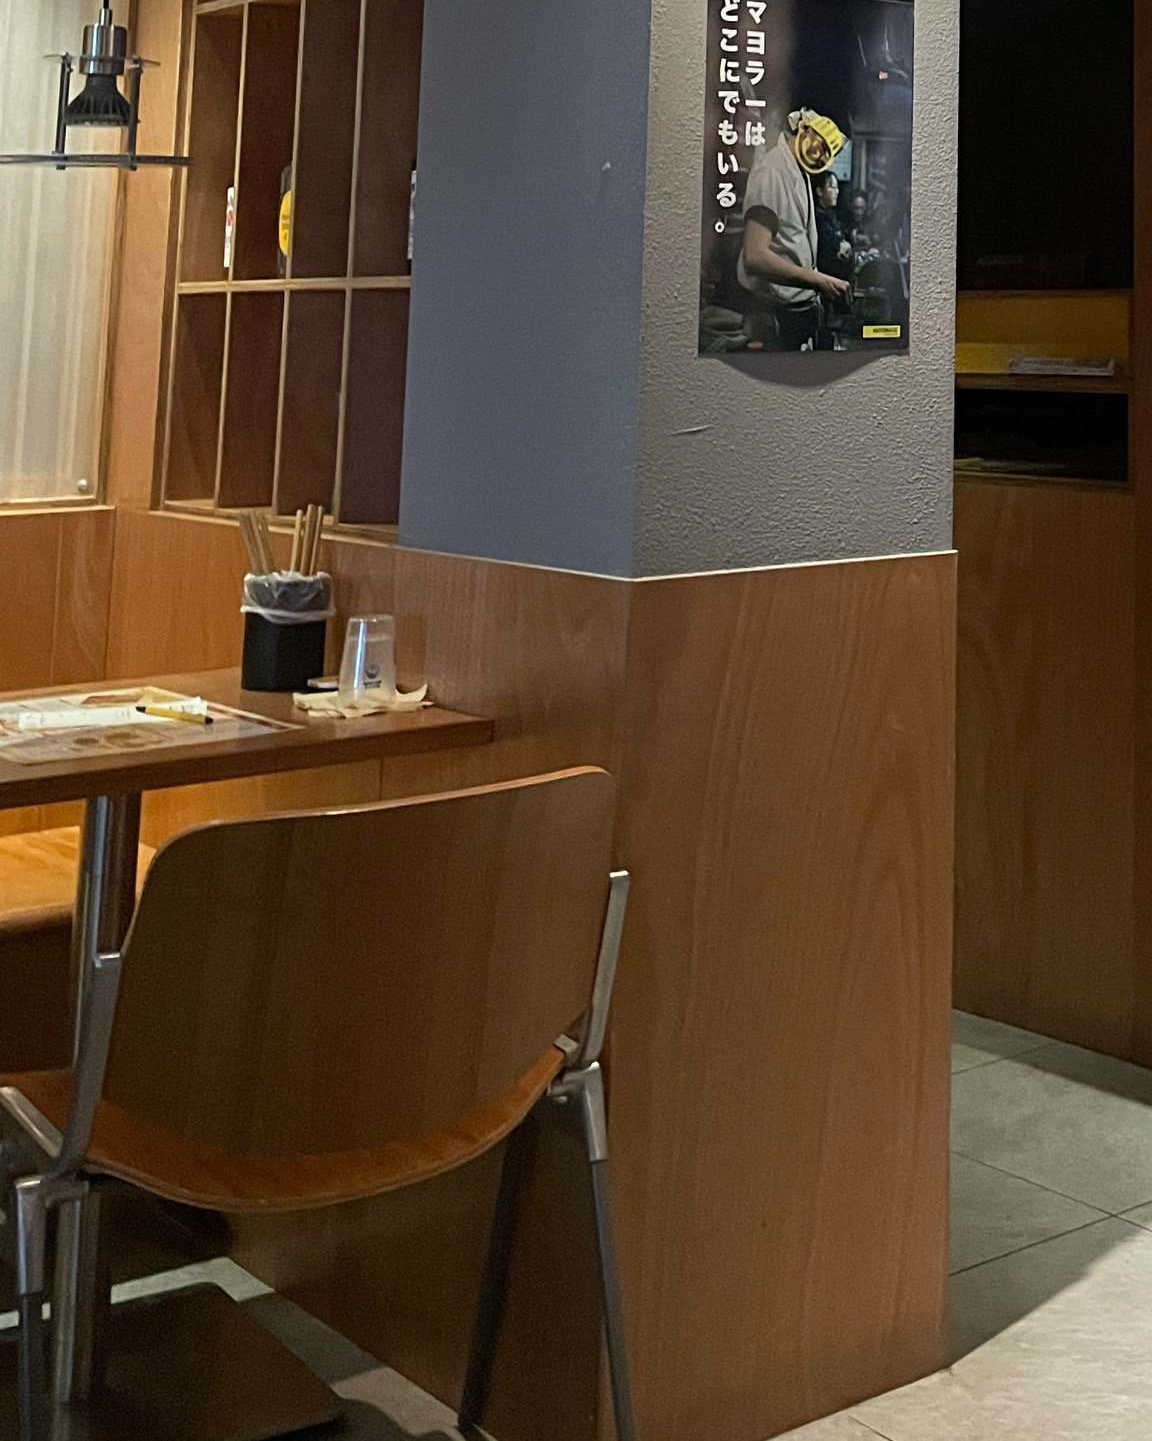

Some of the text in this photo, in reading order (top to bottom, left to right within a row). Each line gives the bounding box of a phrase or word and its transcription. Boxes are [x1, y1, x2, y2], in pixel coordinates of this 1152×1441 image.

[744, 0, 767, 146] マヨラーは
